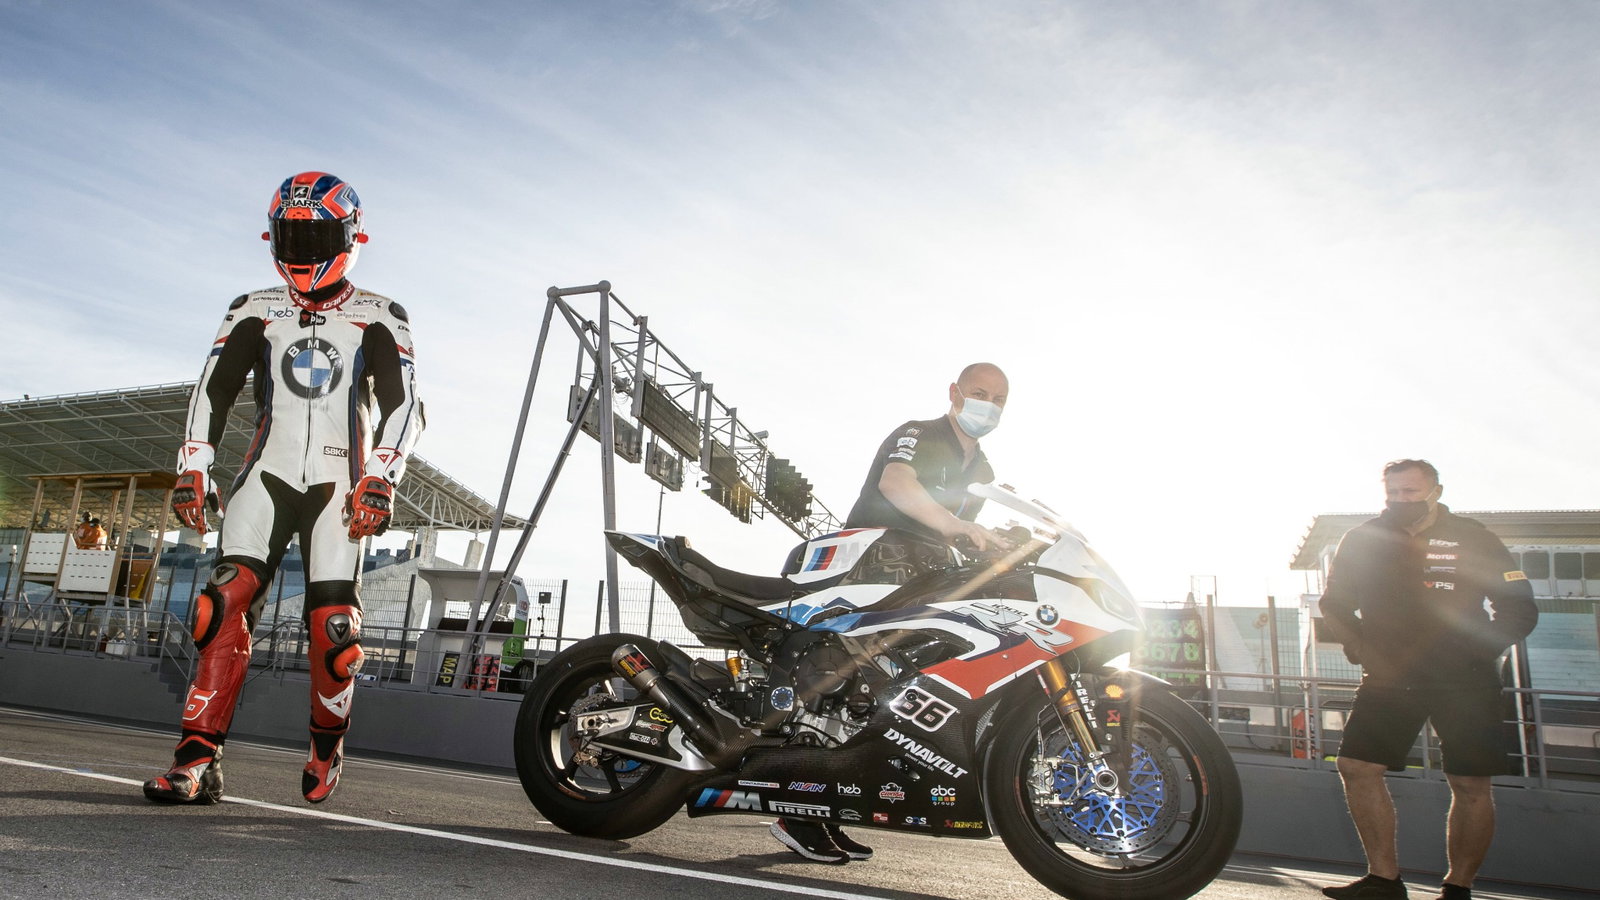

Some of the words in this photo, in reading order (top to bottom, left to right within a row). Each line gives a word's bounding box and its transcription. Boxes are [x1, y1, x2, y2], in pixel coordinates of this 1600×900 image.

[281, 199, 321, 208] SHARK
[267, 306, 295, 318] heb
[287, 339, 339, 358] BMW
[440, 656, 459, 685] MAP
[890, 685, 958, 733] 66
[883, 727, 968, 779] DYNAVOLT
[837, 782, 862, 796] heb
[930, 785, 956, 796] ebc
[768, 800, 831, 818] PIRELLI
